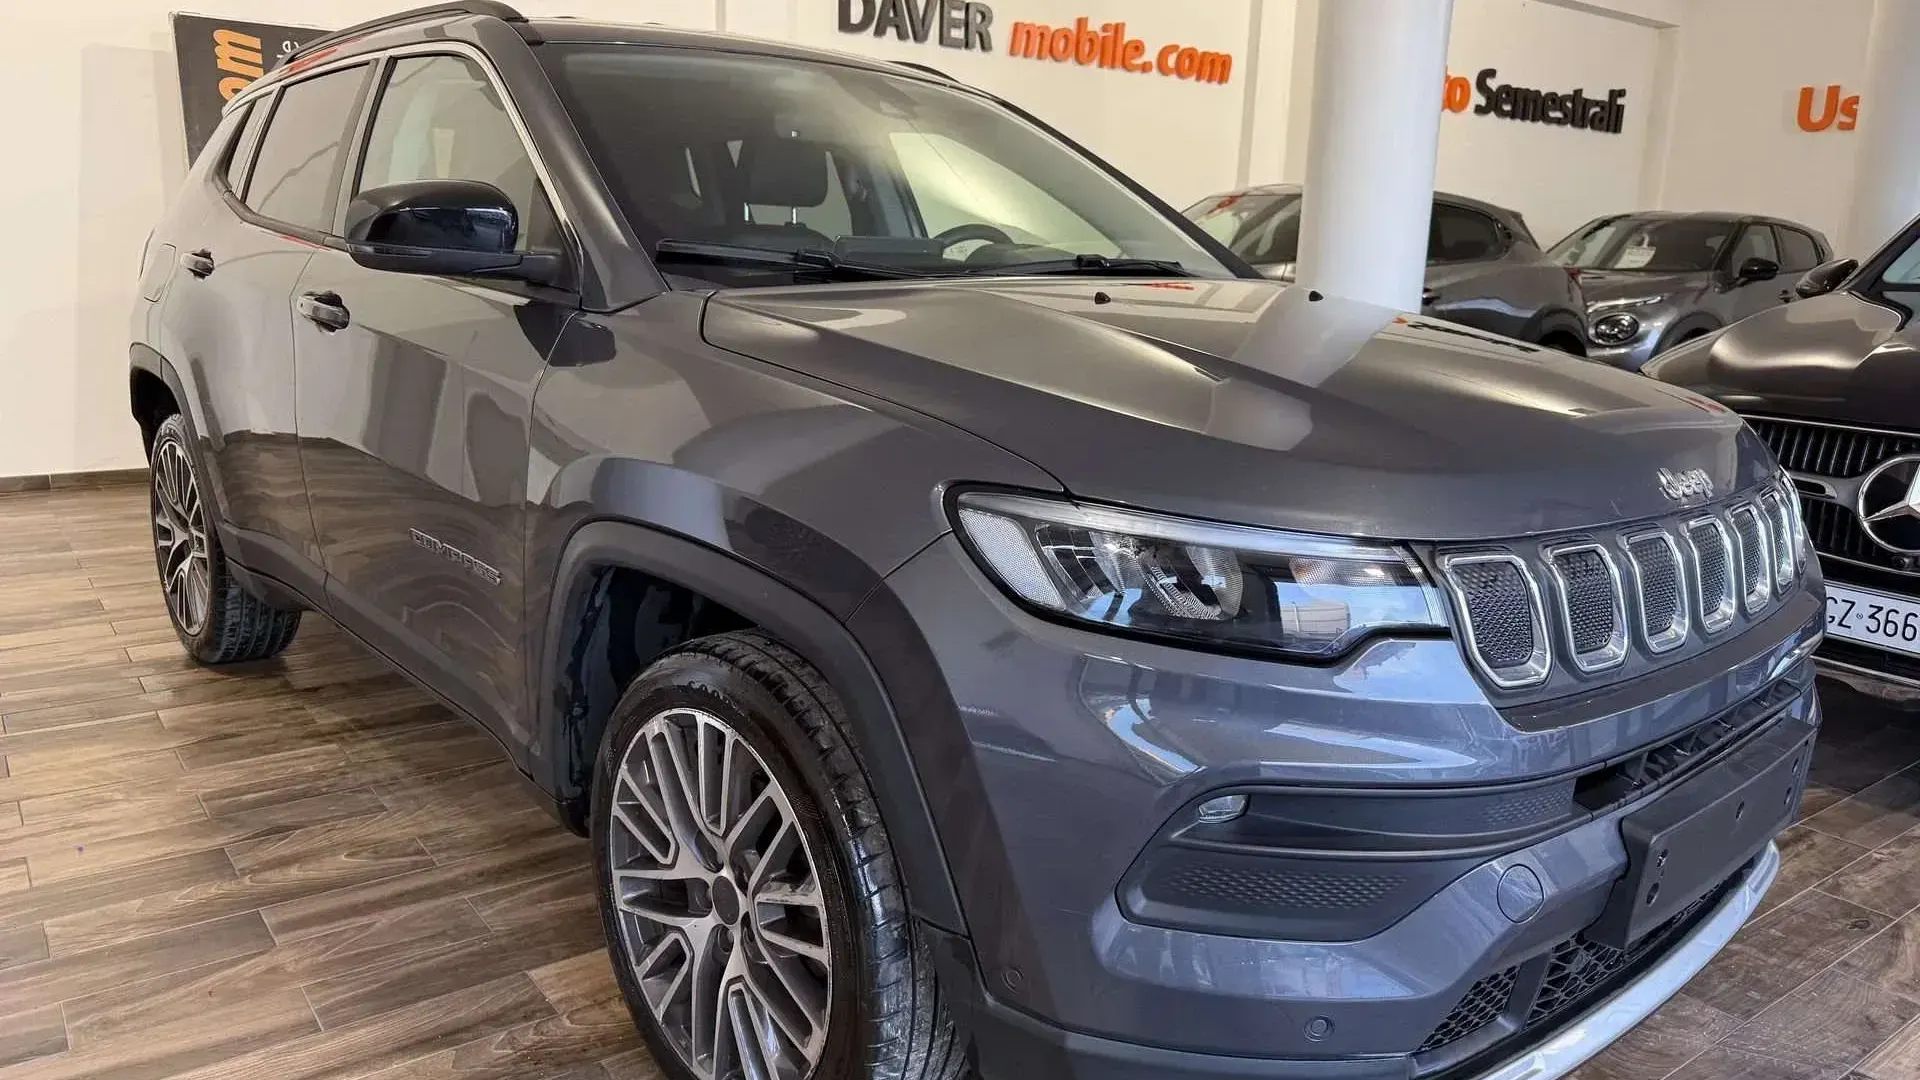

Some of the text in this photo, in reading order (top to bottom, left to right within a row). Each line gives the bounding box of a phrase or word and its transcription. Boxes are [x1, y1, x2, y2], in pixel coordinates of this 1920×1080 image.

[838, 0, 1232, 84] DAVER mobile.com
[1473, 68, 1626, 134] Semestrali
